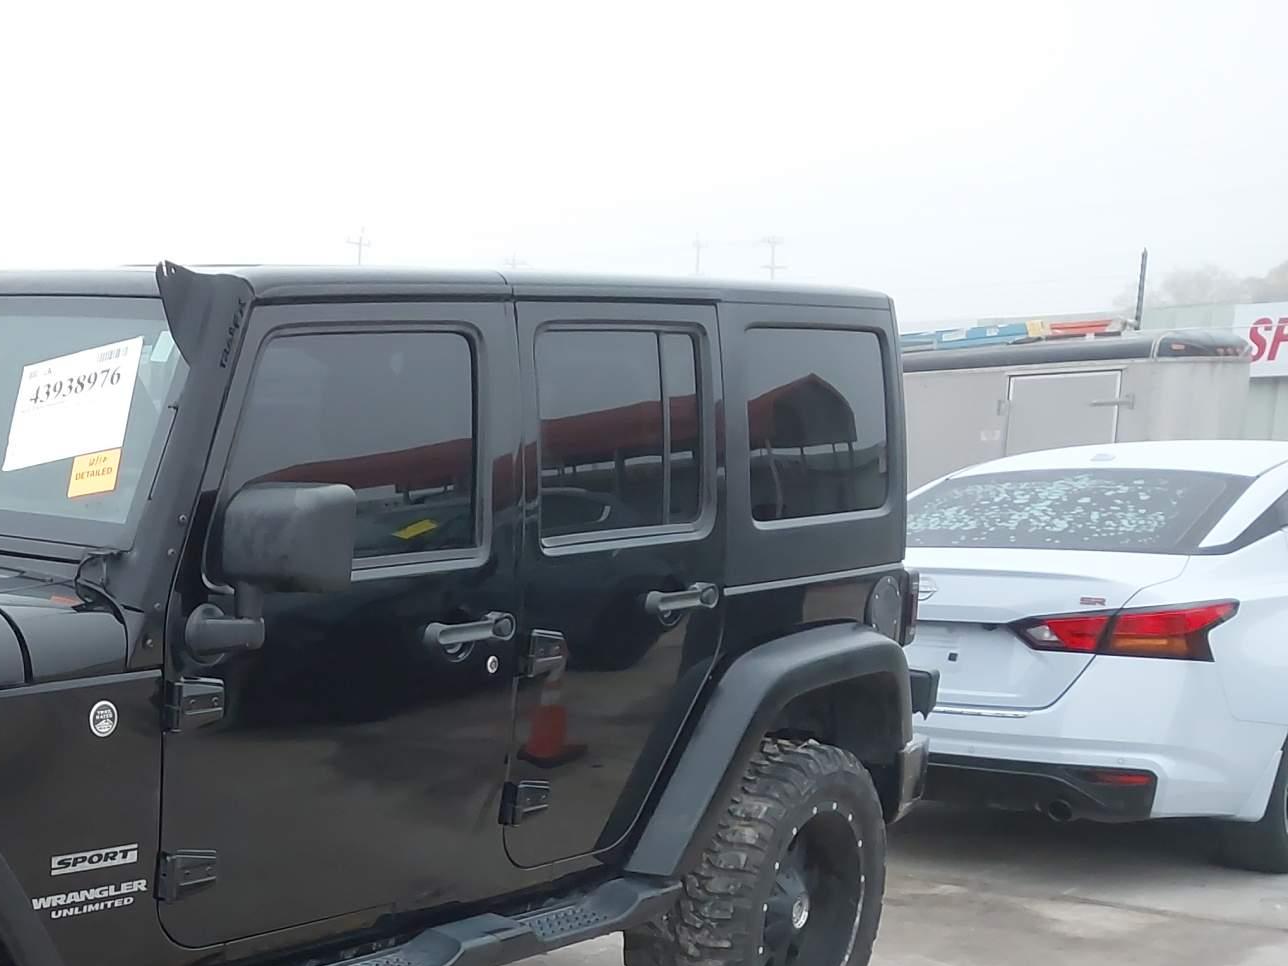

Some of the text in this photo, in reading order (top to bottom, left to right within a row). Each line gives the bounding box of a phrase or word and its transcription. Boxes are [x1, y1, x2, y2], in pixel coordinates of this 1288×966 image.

[29, 366, 121, 405] 43938976
[56, 849, 132, 870] SPORT
[32, 879, 148, 910] WRANGLER
[50, 896, 134, 919] UNLIMITED
